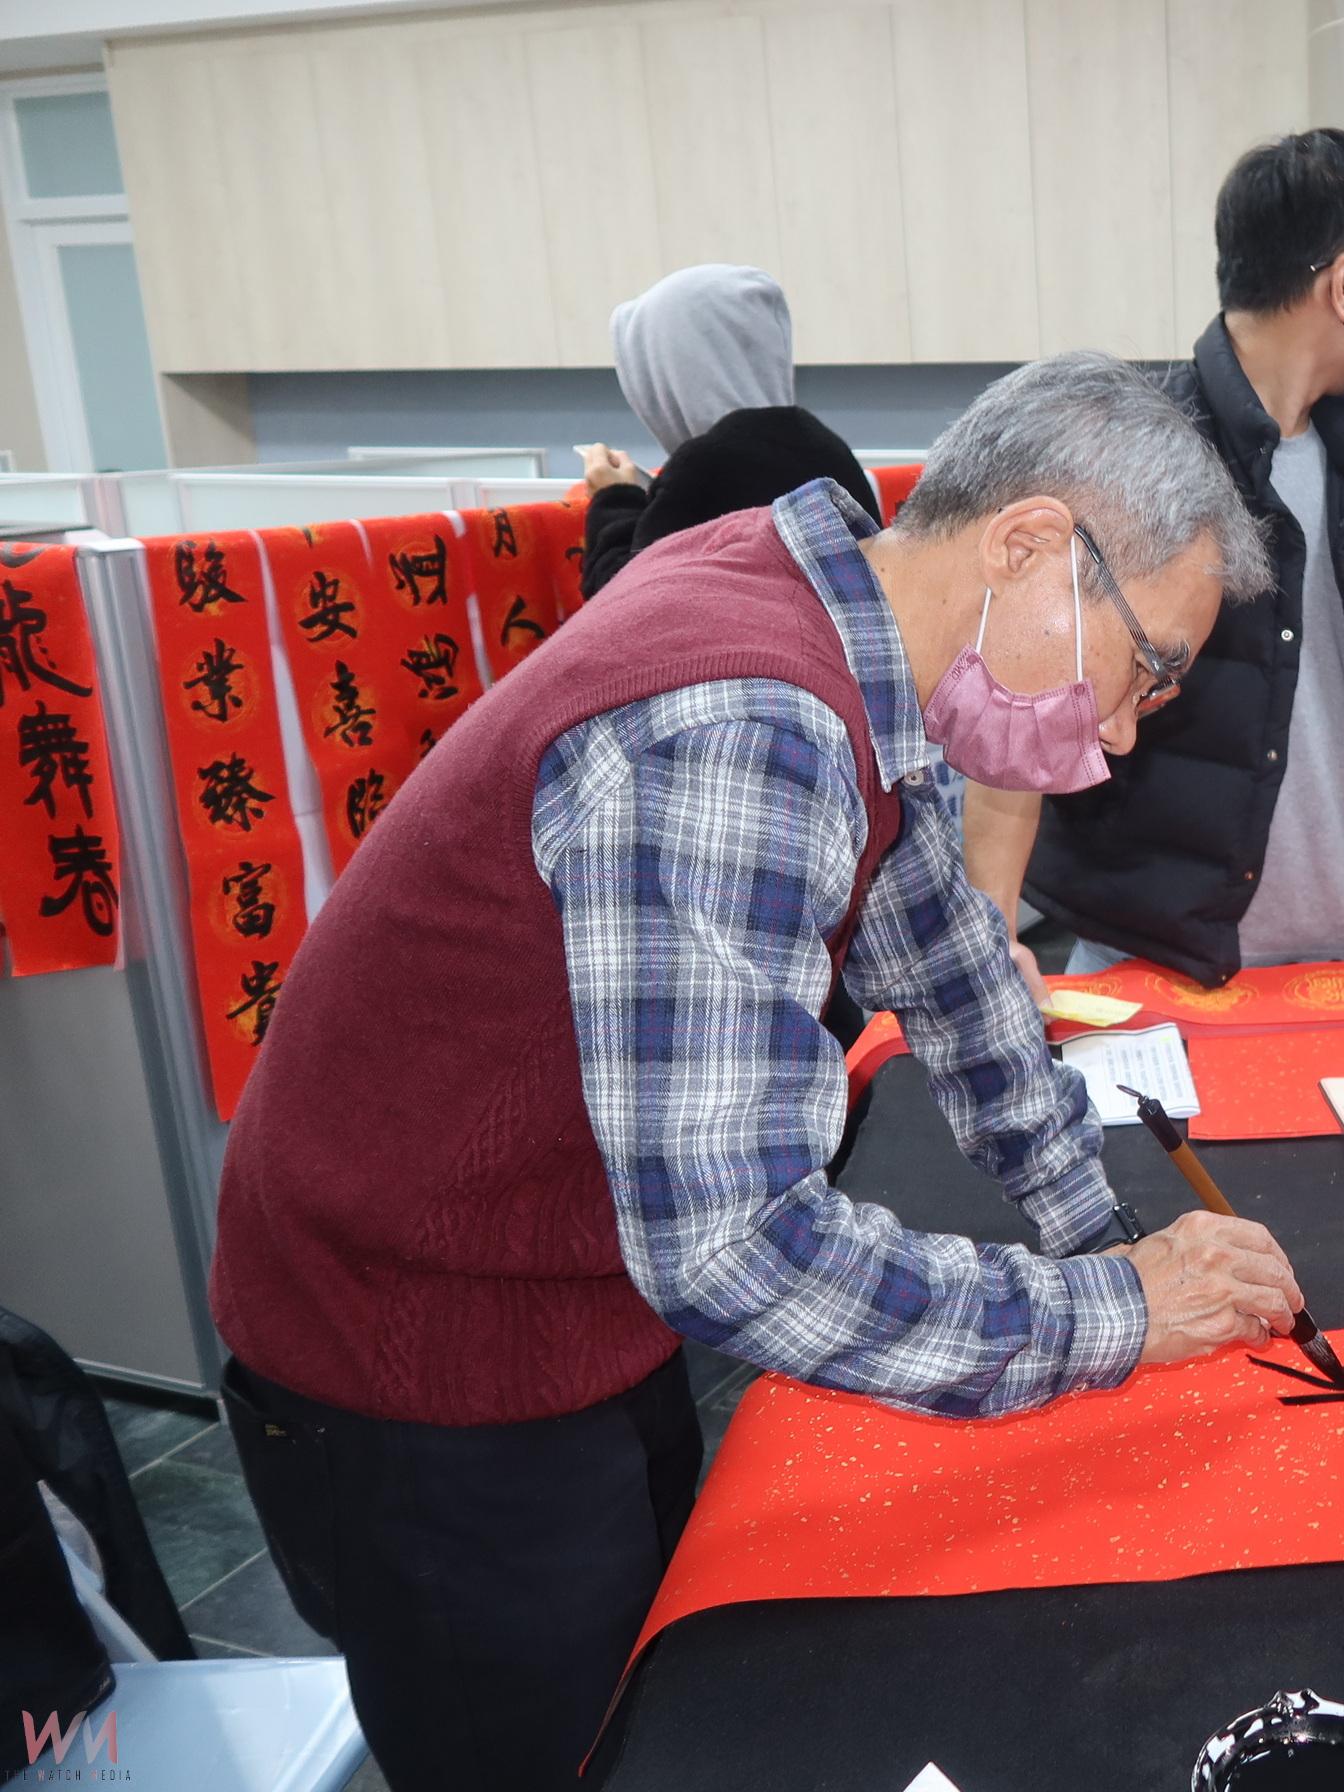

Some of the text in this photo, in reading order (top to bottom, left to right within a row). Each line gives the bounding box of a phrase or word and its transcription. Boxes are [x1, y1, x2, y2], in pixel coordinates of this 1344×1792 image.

[0, 541, 119, 937] 龍舞春
[298, 528, 389, 838] 安喜臨
